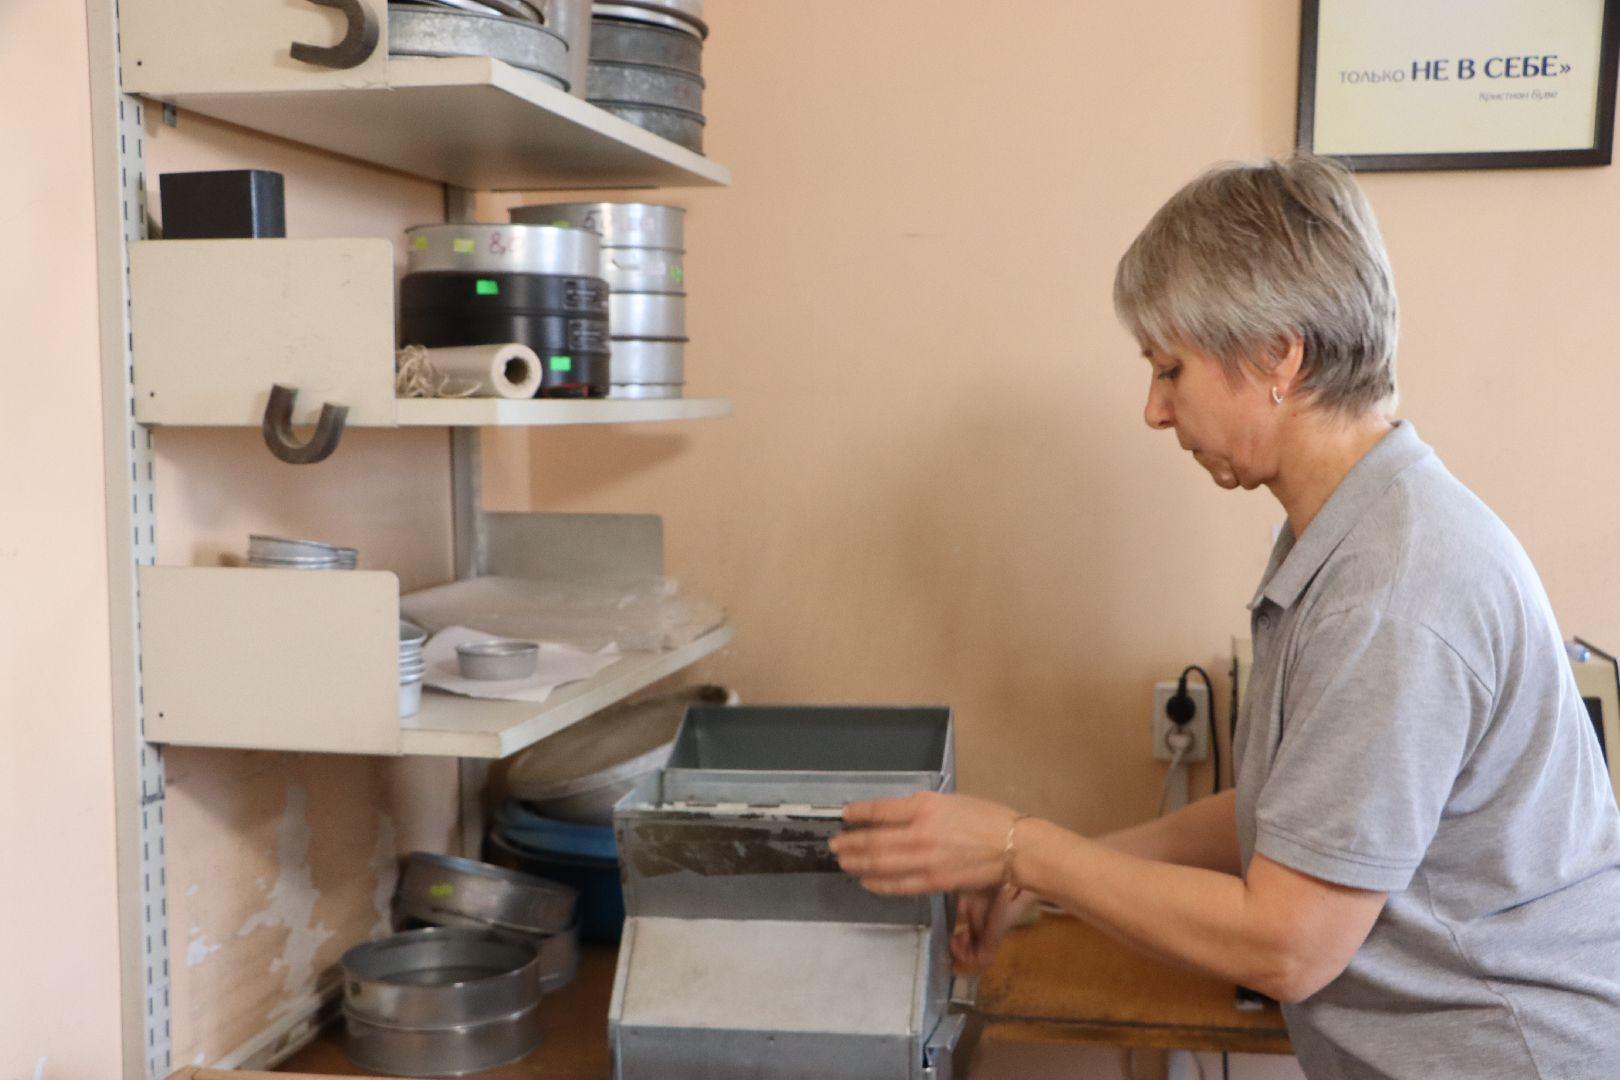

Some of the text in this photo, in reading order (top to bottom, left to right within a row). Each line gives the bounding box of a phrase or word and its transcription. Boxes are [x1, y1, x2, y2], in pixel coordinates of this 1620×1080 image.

[1411, 59, 1449, 81] НЕ
[1457, 58, 1476, 80] В
[1484, 55, 1572, 79] СЕБЕ»
